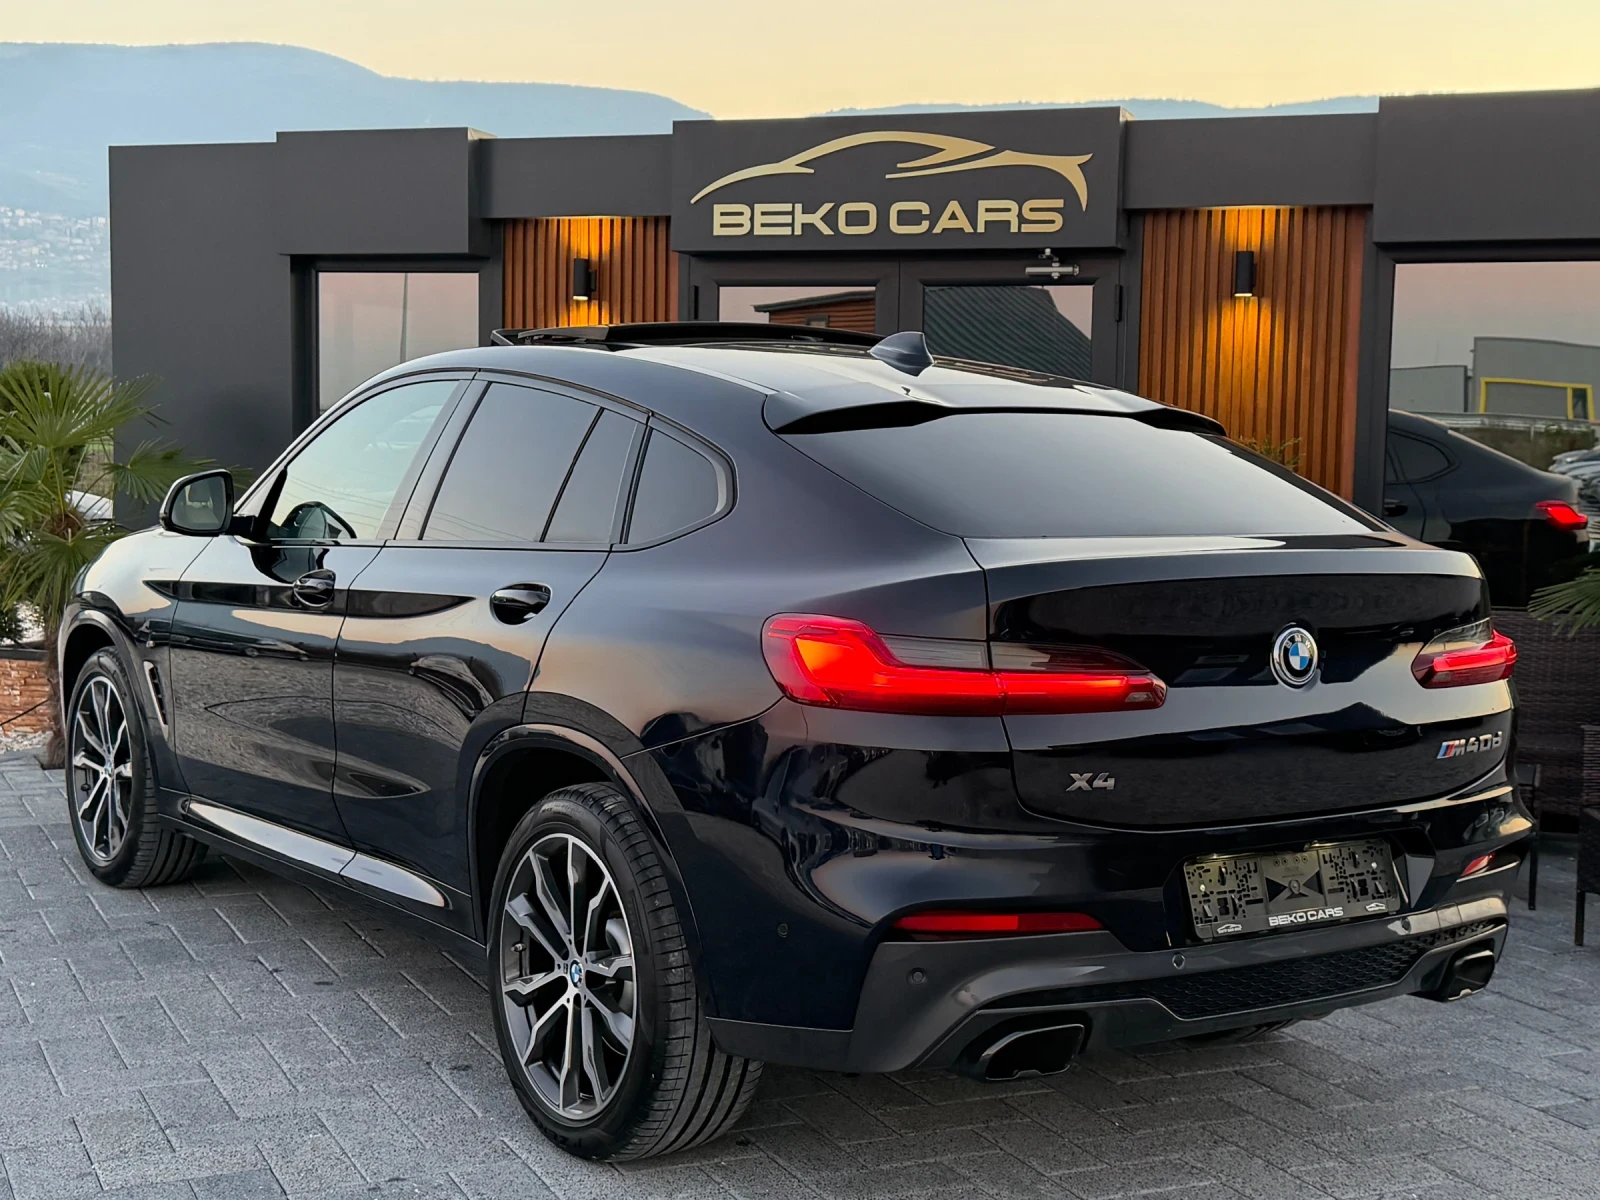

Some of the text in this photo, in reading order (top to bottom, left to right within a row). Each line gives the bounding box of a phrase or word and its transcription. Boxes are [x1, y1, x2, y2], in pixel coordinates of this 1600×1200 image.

[713, 198, 1064, 236] BEKO CARS
[1065, 772, 1116, 792] X4
[1268, 906, 1344, 926] BEKO CARS
